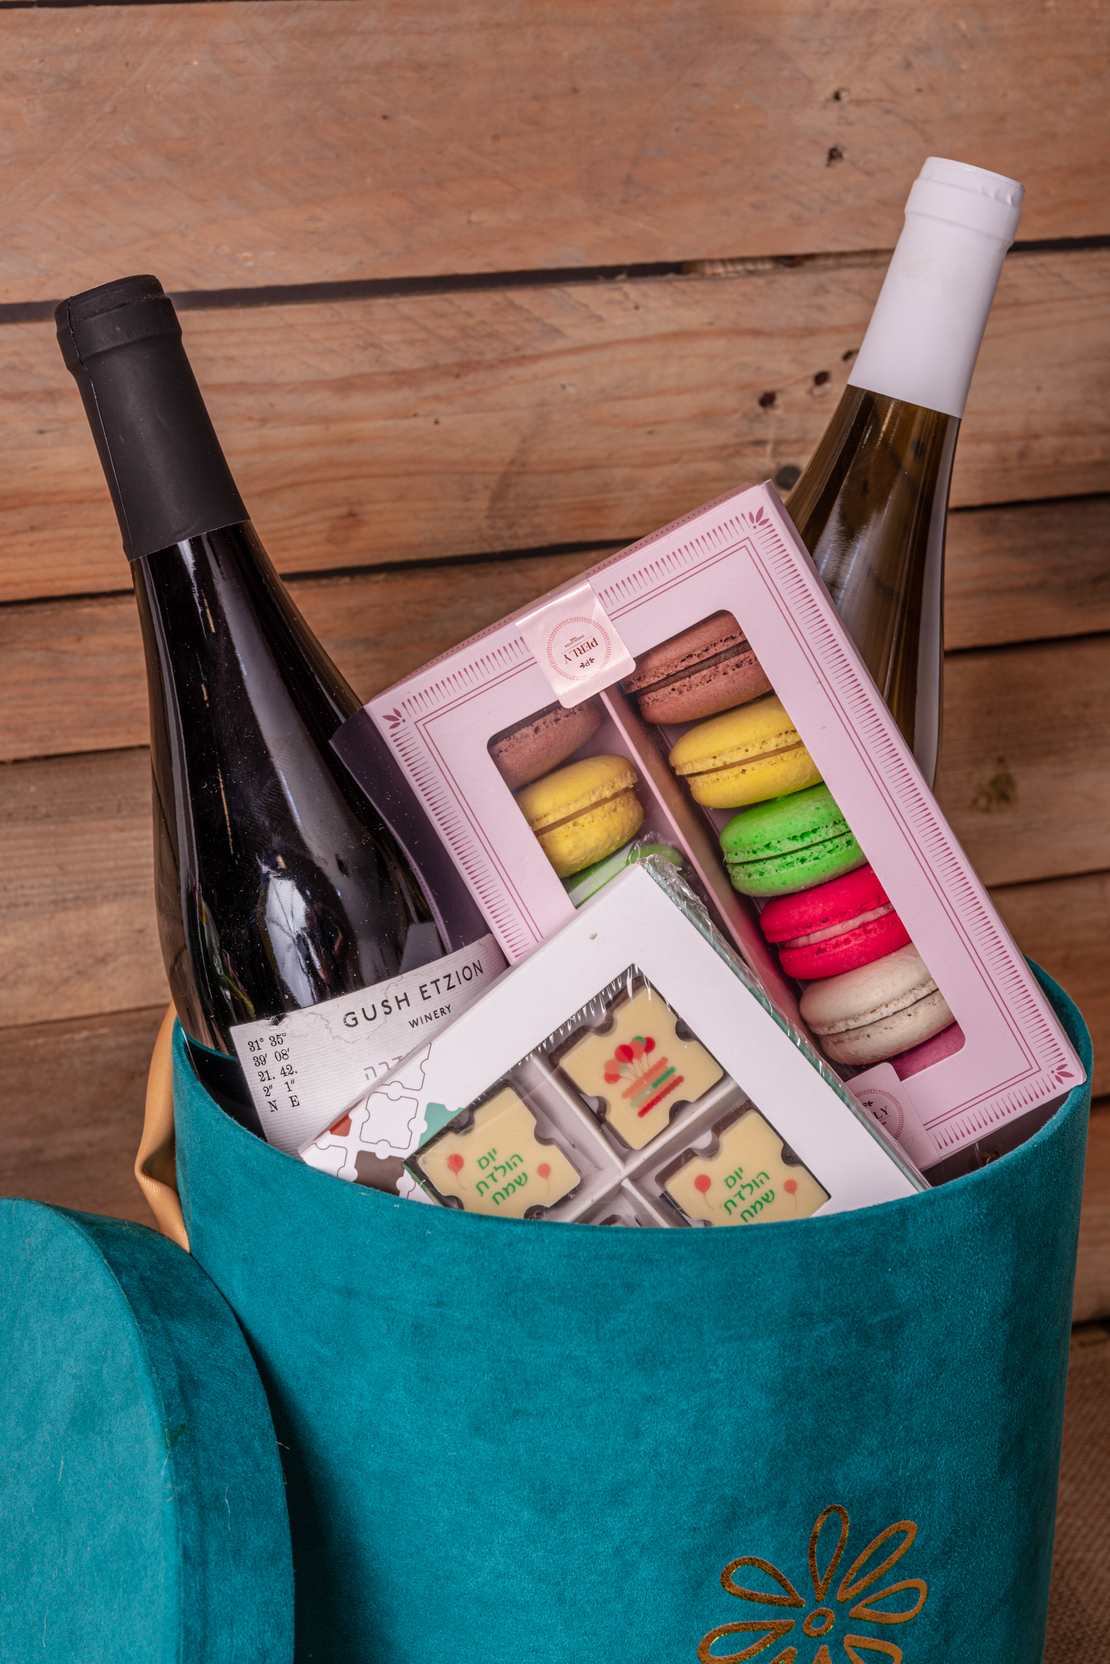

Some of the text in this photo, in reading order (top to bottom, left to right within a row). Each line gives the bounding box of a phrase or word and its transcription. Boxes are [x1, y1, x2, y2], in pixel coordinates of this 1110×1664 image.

[563, 637, 599, 664] PERLY
[343, 959, 484, 1028] GUSH ETZION
[408, 1004, 453, 1029] WINERY
[258, 1064, 298, 1082] 21. 42.
[267, 1095, 300, 1113] N E
[476, 1148, 498, 1171] יום
[475, 1153, 524, 1197] הולדת
[491, 1171, 528, 1205] שמח
[723, 1166, 744, 1189] יום
[723, 1171, 771, 1216] הולדת
[740, 1189, 775, 1223] שמח
